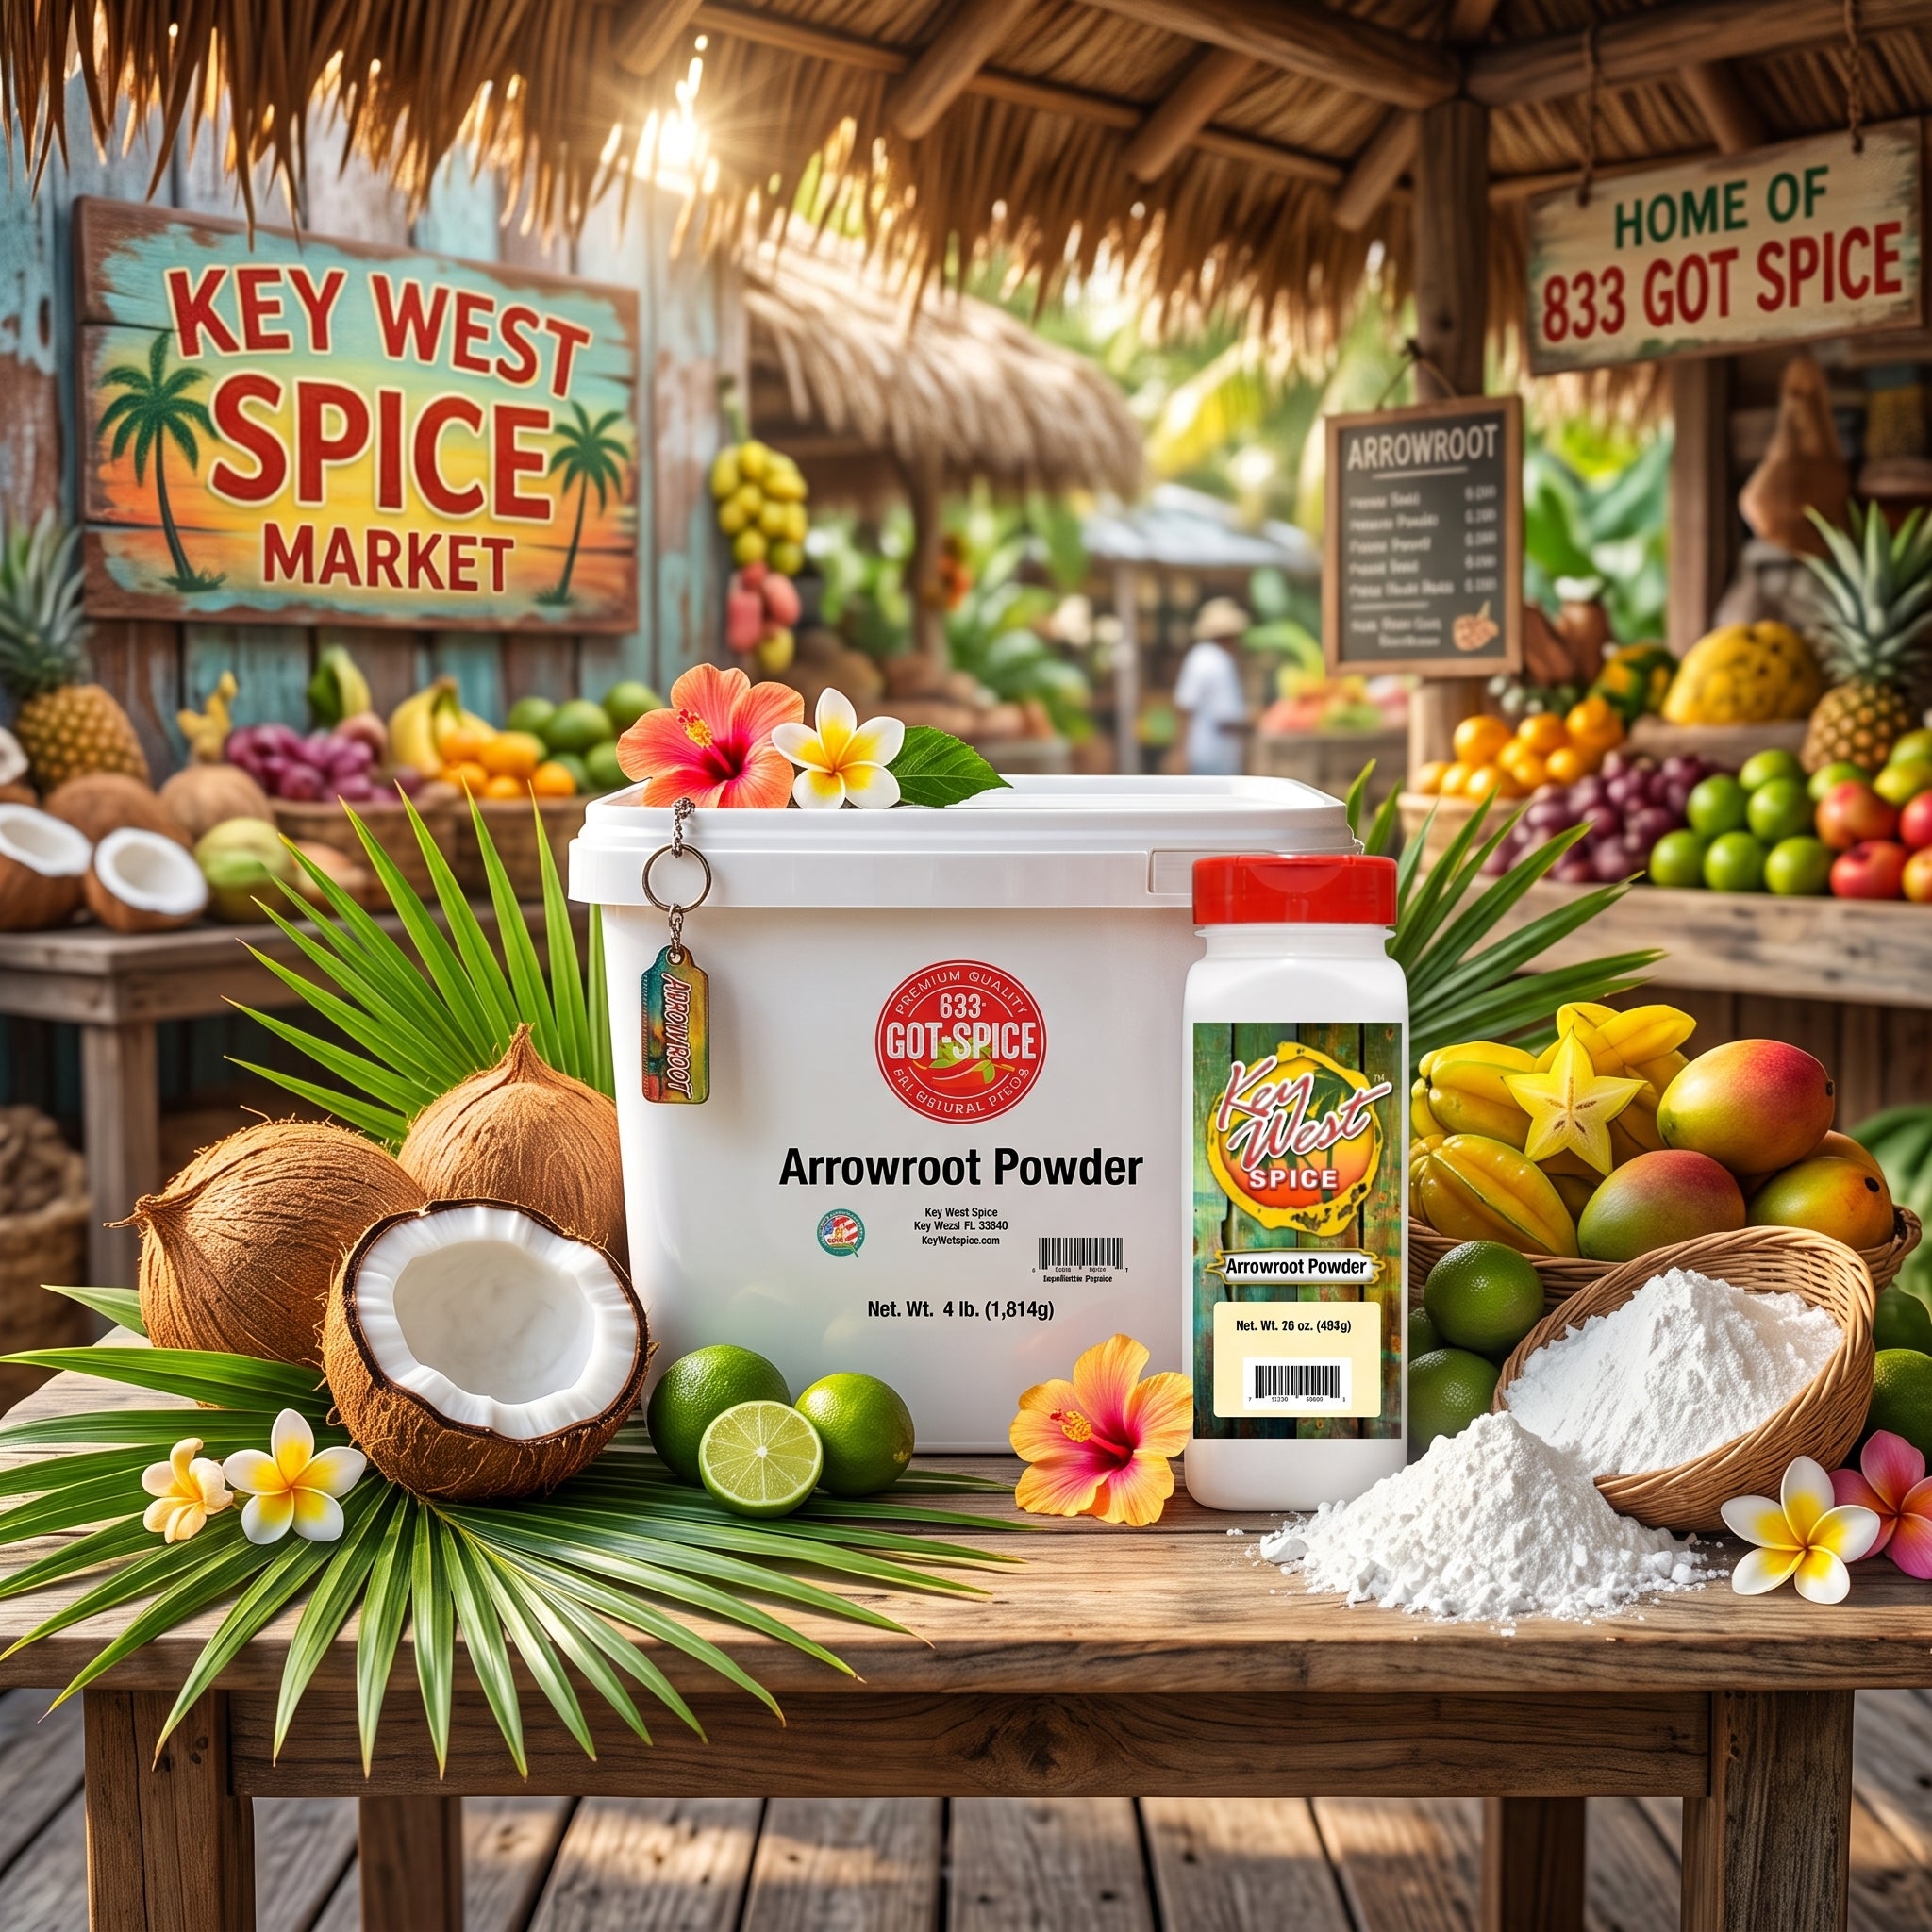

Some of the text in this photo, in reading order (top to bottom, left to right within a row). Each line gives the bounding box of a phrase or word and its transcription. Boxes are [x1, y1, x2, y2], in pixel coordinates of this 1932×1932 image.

[1615, 165, 1829, 249] HOME OF
[1542, 222, 1903, 343] 833 GOT SPICE
[166, 266, 591, 398] KEY WEST
[209, 372, 553, 521] SPICE
[1347, 424, 1499, 471] ARROWROOT
[262, 522, 514, 592] MARKET
[895, 971, 1027, 1015] PREMIUM QUALITY
[1217, 1055, 1314, 1132] Key
[1226, 1081, 1392, 1171] West
[778, 1147, 1144, 1186] Arrowroot Powder
[1249, 1169, 1338, 1190] SPICE
[914, 1221, 931, 1233] Key
[964, 1221, 976, 1230] FL
[924, 1207, 998, 1219] Key West Spice
[922, 1235, 1000, 1247] KeyWetspice.com
[1226, 1258, 1367, 1274] Arrowroot Powder
[868, 1301, 1055, 1322] Net. Wt. 4 lb. (1,814g)
[1236, 1320, 1257, 1331] Net.
[1260, 1320, 1278, 1331] Wt.
[1298, 1322, 1313, 1331] oz.
